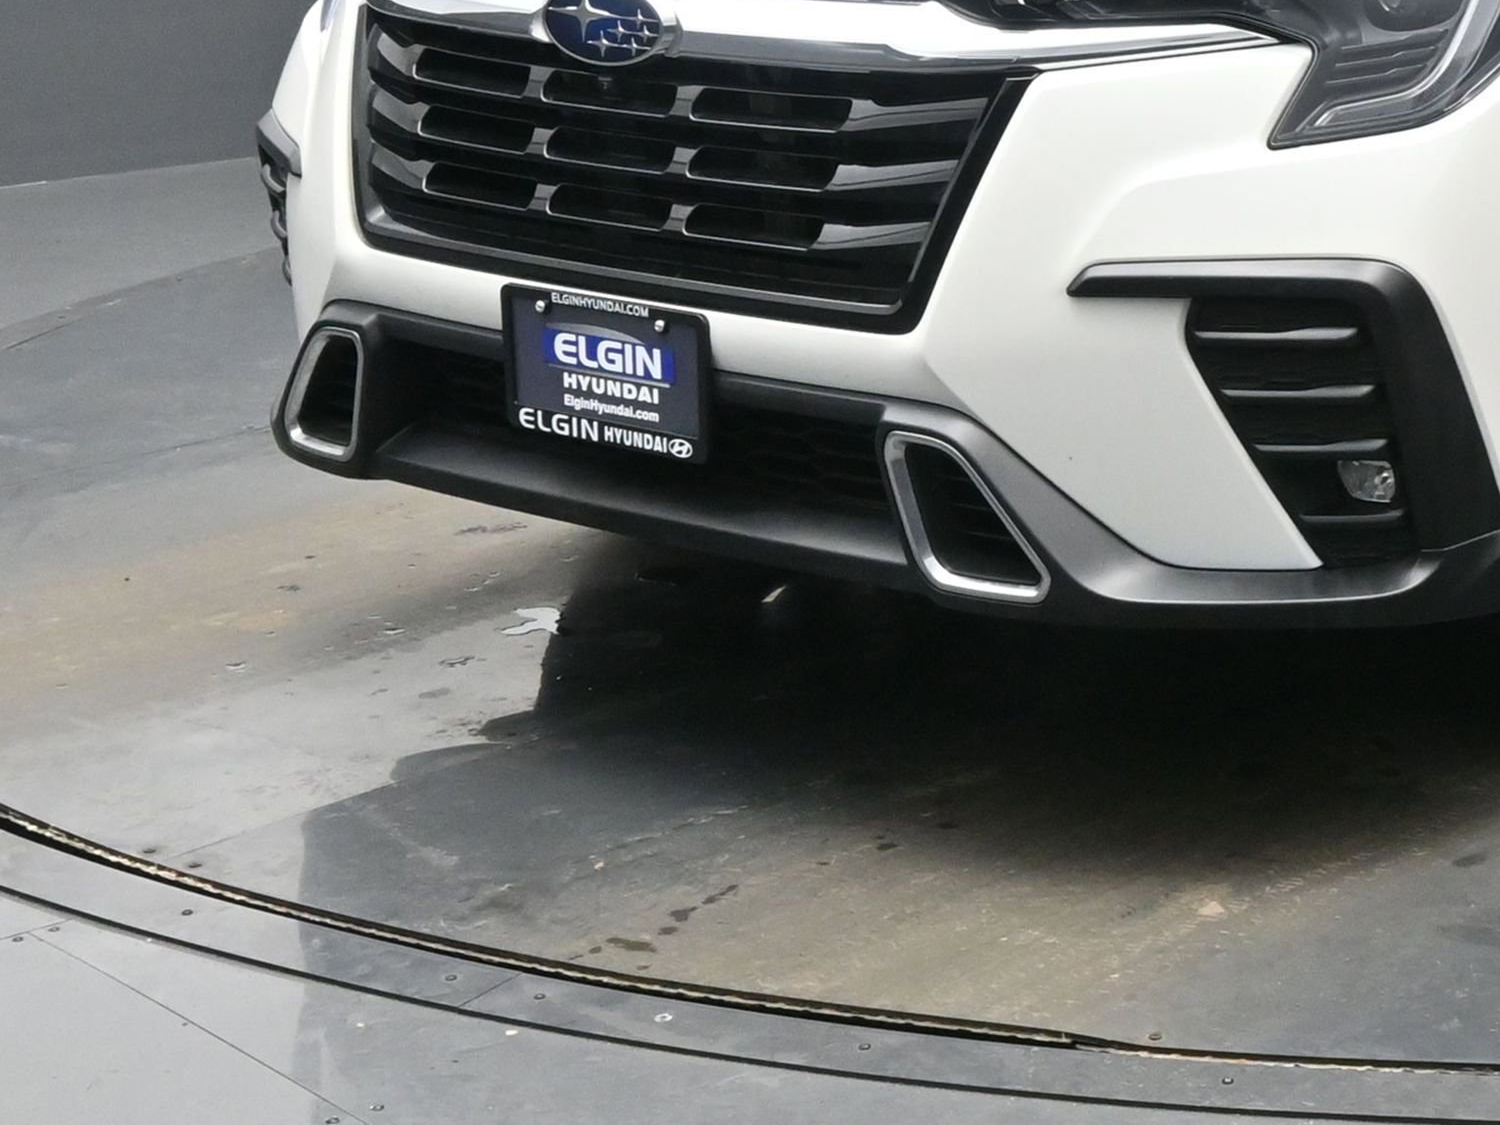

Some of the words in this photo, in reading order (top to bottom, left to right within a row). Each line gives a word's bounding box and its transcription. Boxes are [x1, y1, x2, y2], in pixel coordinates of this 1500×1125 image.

[551, 292, 649, 318] ELGINHYUNDAI.COM
[553, 332, 662, 380] ELGIN
[563, 372, 660, 404] HYUNDAI
[563, 393, 660, 422] ElginHyundai.com
[518, 407, 599, 442] ELGIN
[604, 425, 668, 454] HYUNDAI
